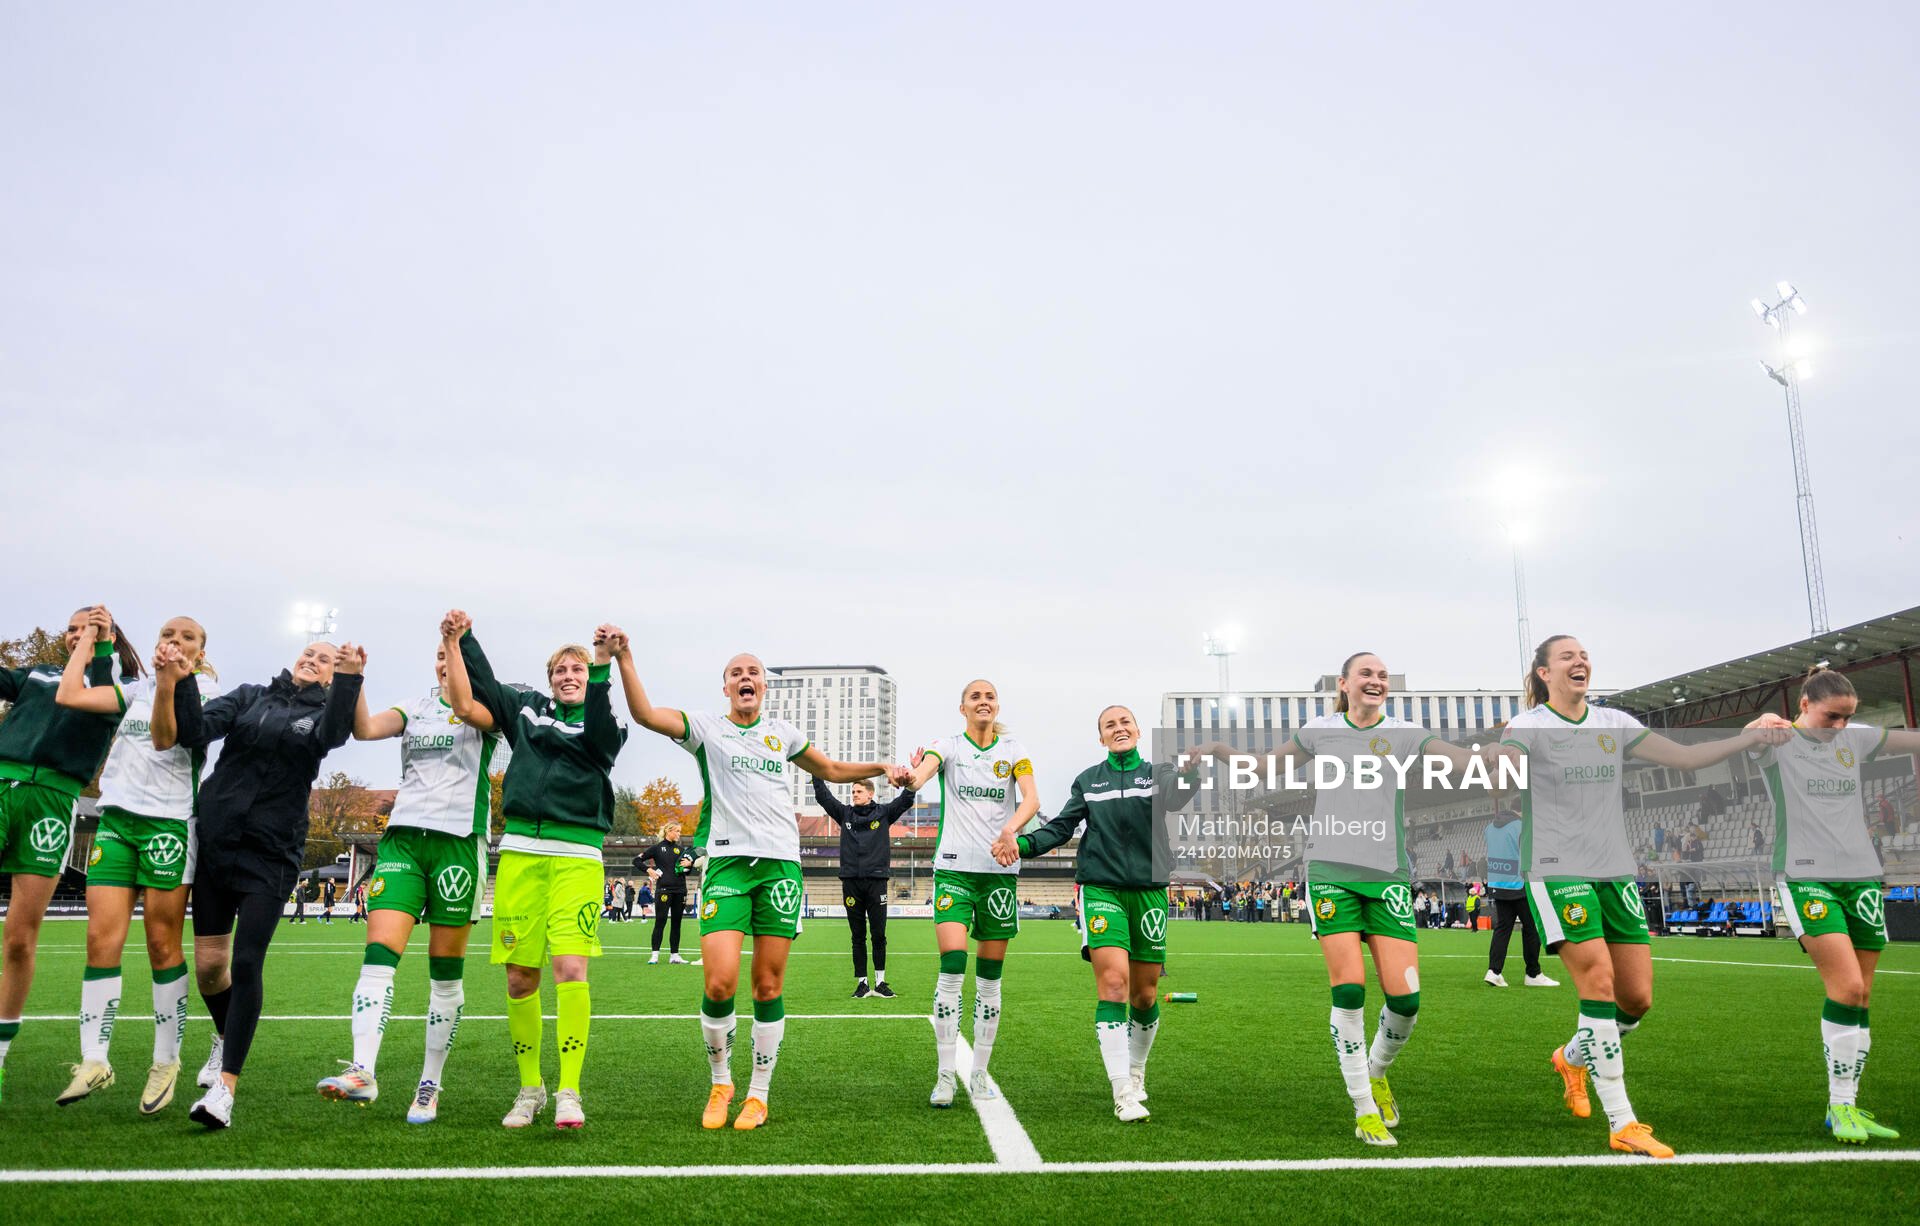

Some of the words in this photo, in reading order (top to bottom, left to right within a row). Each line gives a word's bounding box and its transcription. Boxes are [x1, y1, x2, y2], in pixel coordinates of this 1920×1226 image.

[408, 735, 454, 747] PROJOB
[731, 755, 783, 774] PROJOB
[1564, 764, 1616, 780] PROJOB
[959, 785, 1005, 799] PROJOB
[1807, 778, 1857, 792] PROJOB
[1488, 861, 1512, 872] HOTO
[97, 998, 120, 1042] Clinton
